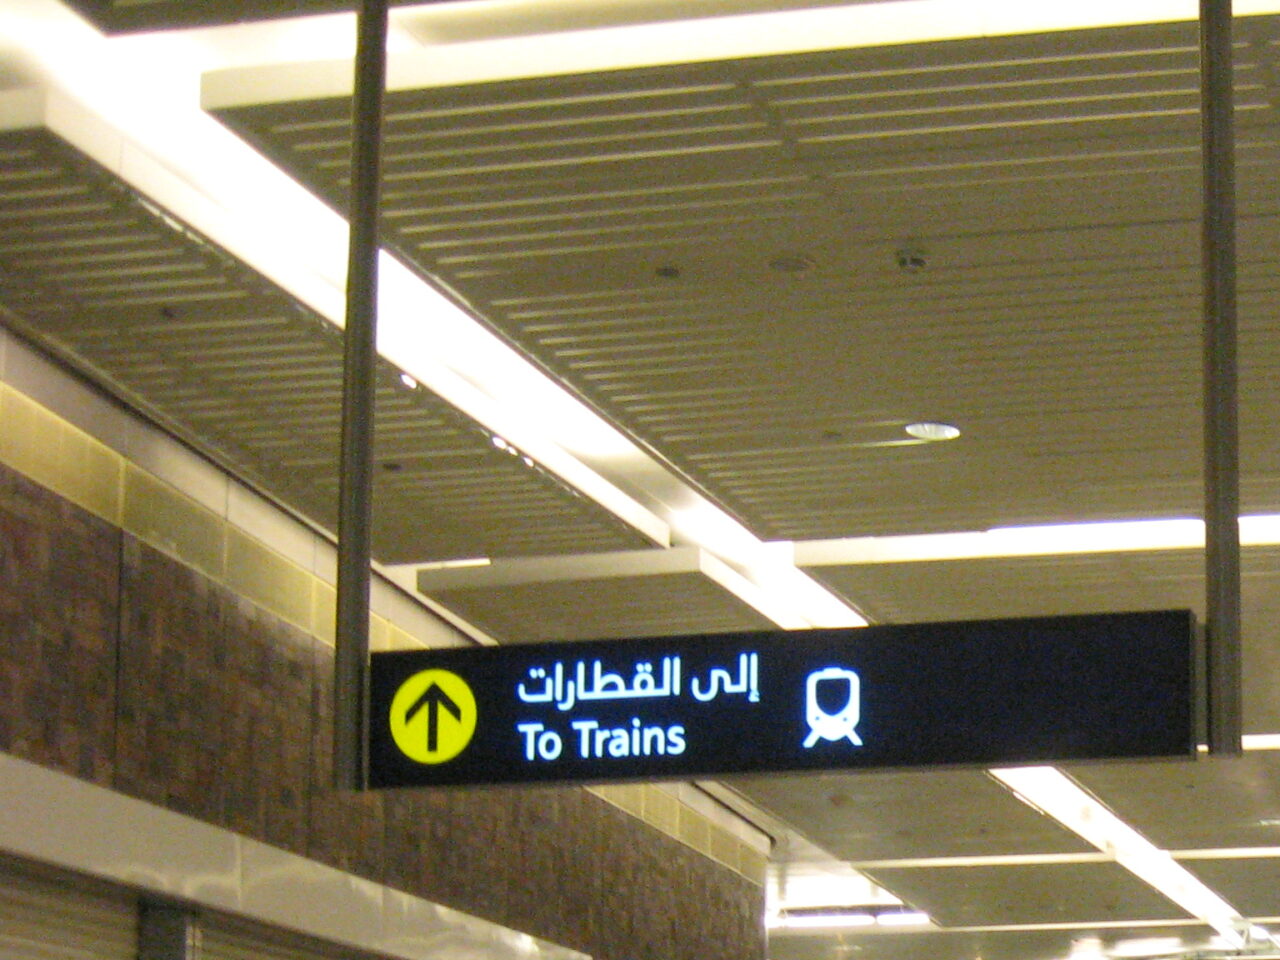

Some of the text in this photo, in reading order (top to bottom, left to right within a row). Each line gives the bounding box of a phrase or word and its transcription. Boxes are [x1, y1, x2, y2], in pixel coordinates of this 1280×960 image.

[518, 652, 760, 711] إلى القطارات
[517, 717, 686, 760] To Trains
